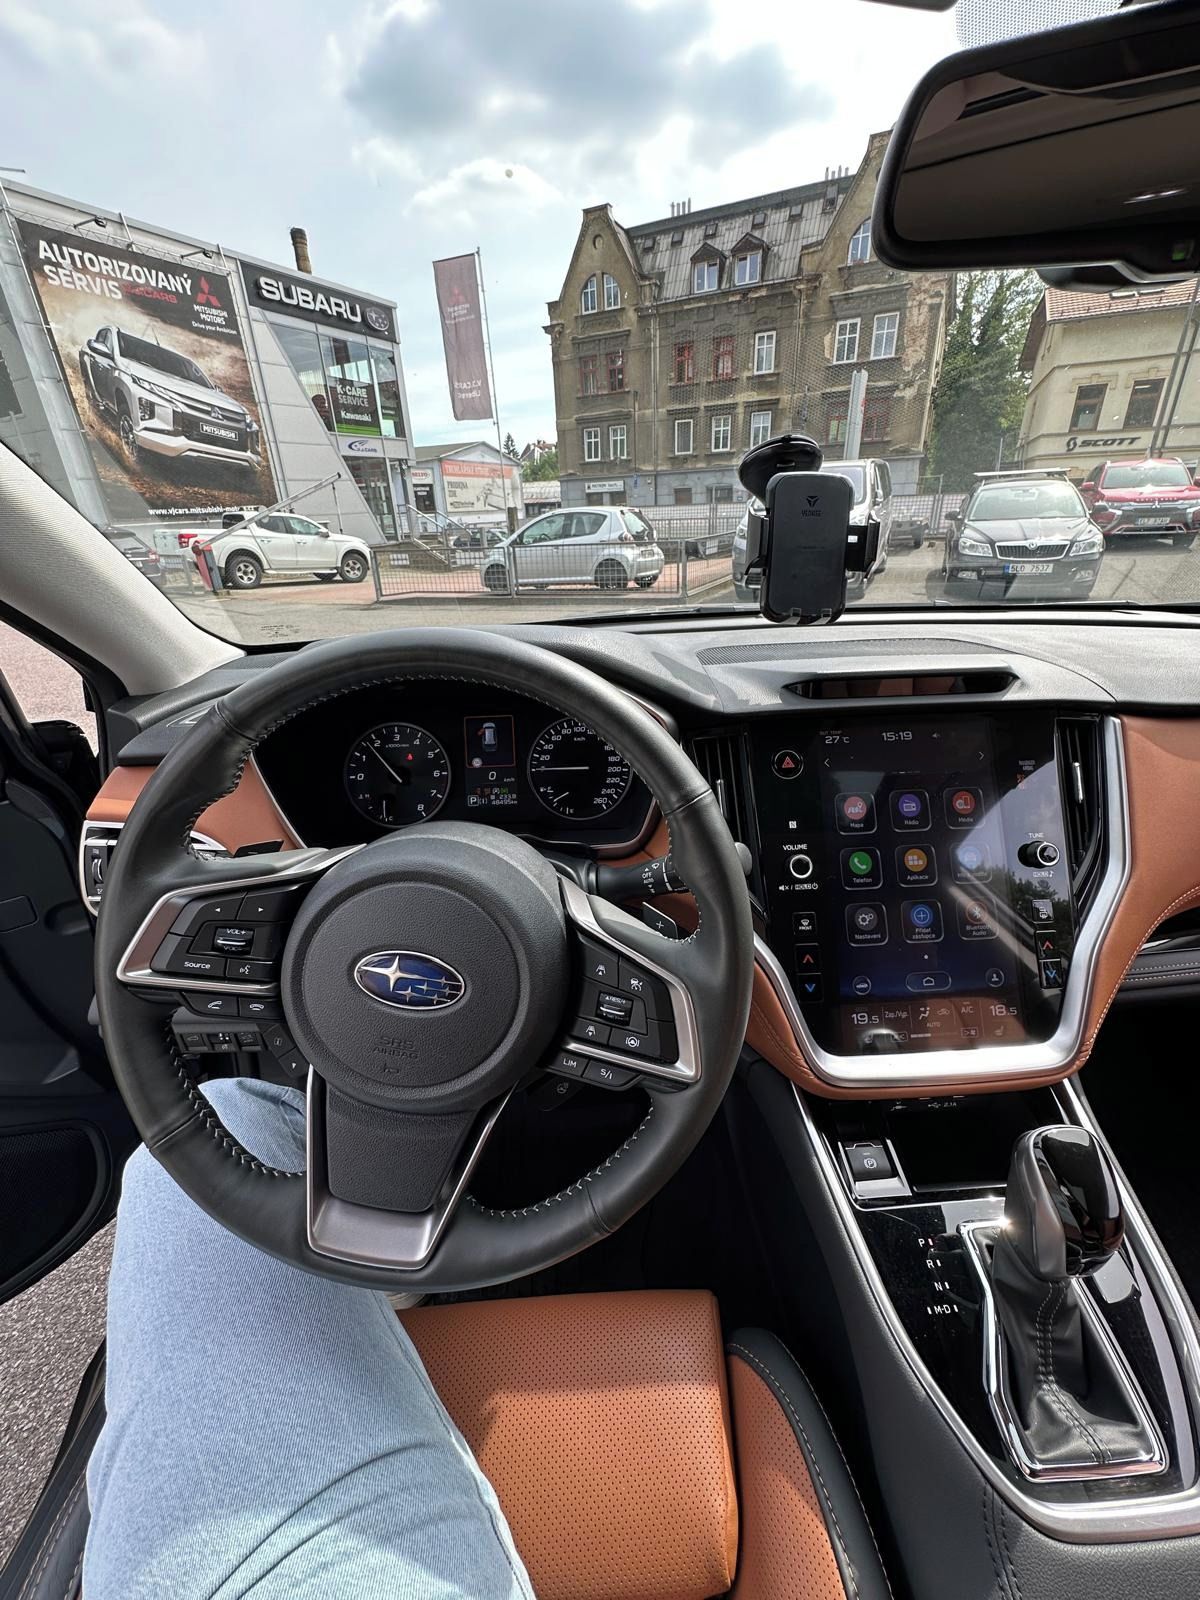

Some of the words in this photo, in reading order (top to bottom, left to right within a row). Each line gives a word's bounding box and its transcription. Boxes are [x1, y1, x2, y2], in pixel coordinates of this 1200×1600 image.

[38, 239, 192, 296] AUTORIZOVANÝ
[43, 264, 123, 300] SERVIS
[259, 276, 362, 323] SUBARU
[193, 303, 228, 318] MITSUBISHI
[200, 313, 226, 325] MOTORS
[338, 395, 369, 407] SERVICE
[341, 410, 372, 422] Kawasaki
[202, 424, 236, 439] MITSUBISHI
[1078, 436, 1142, 448] SCOTT
[1031, 564, 1051, 572] 7537
[825, 735, 840, 744] 27
[881, 731, 913, 741] 15:19
[488, 771, 497, 780] 0
[782, 843, 808, 851] VOLUME
[184, 961, 211, 969] Source
[960, 1006, 974, 1014] A/C
[989, 1005, 1018, 1017] 18.5
[851, 1012, 880, 1025] 19.5
[563, 1058, 577, 1068] LIM
[917, 1238, 925, 1248] P
[926, 1259, 935, 1269] R
[933, 1281, 943, 1291] N
